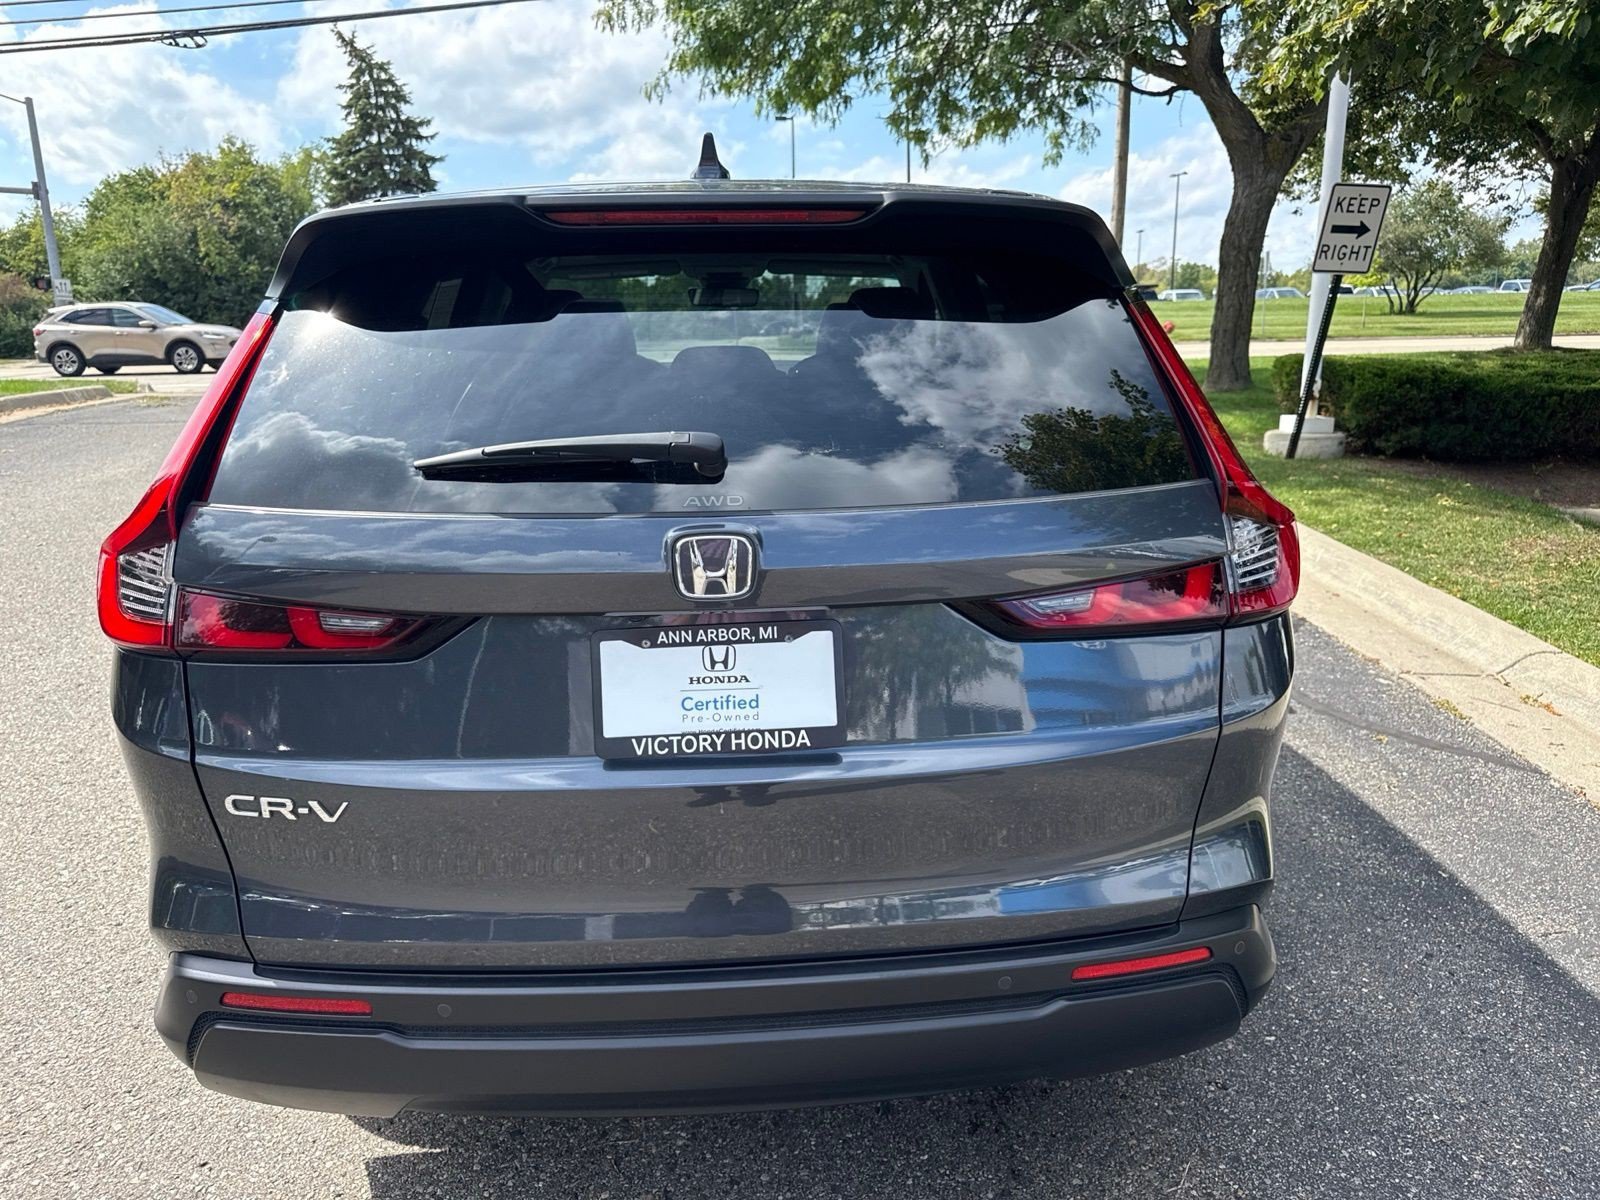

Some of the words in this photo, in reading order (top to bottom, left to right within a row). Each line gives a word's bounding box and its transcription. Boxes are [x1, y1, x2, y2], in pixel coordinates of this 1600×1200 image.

[1334, 196, 1381, 214] KEEP
[1319, 244, 1372, 261] RIGHT
[683, 495, 743, 507] AWD
[657, 630, 692, 644] ANN
[696, 627, 756, 643] ARBOR,
[759, 626, 778, 640] MI
[688, 675, 751, 685] HONDA
[681, 693, 759, 711] Certified
[682, 711, 759, 722] Pre-Owned
[632, 733, 726, 756] VICTORY
[731, 729, 811, 751] HONDA
[224, 794, 349, 823] CR-V
